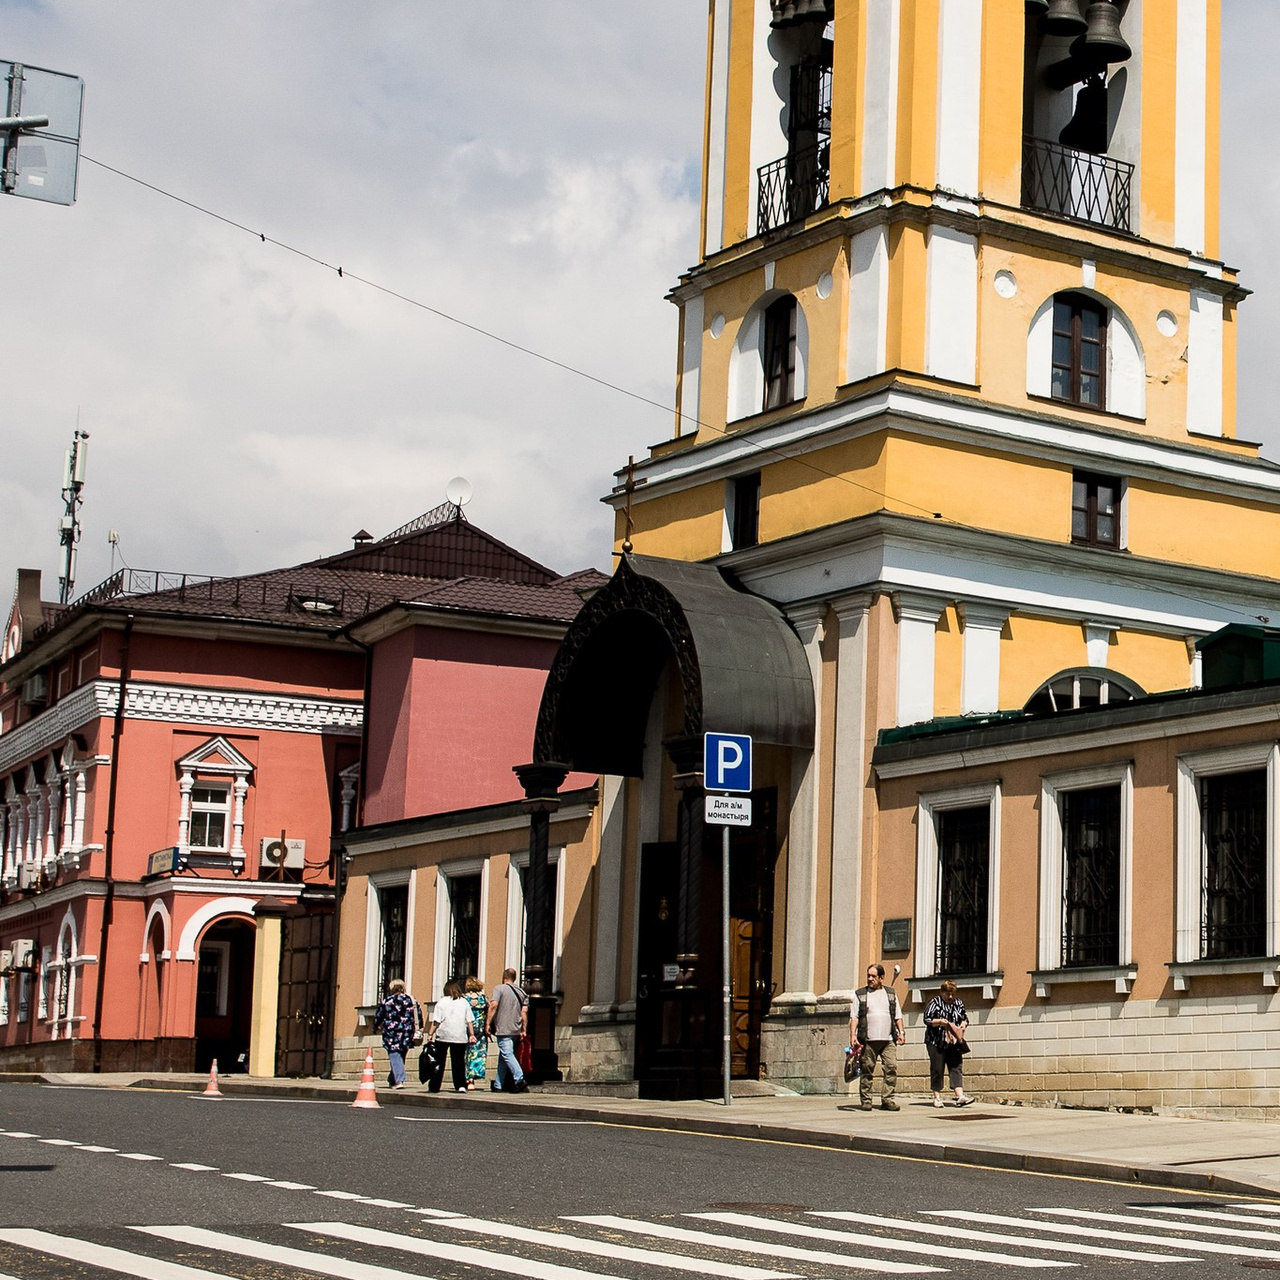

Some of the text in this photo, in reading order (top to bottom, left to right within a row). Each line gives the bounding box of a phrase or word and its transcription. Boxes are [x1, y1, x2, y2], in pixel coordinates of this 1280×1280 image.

[717, 740, 743, 784] P
[714, 800, 729, 809] Для
[708, 812, 749, 821] монастыря
